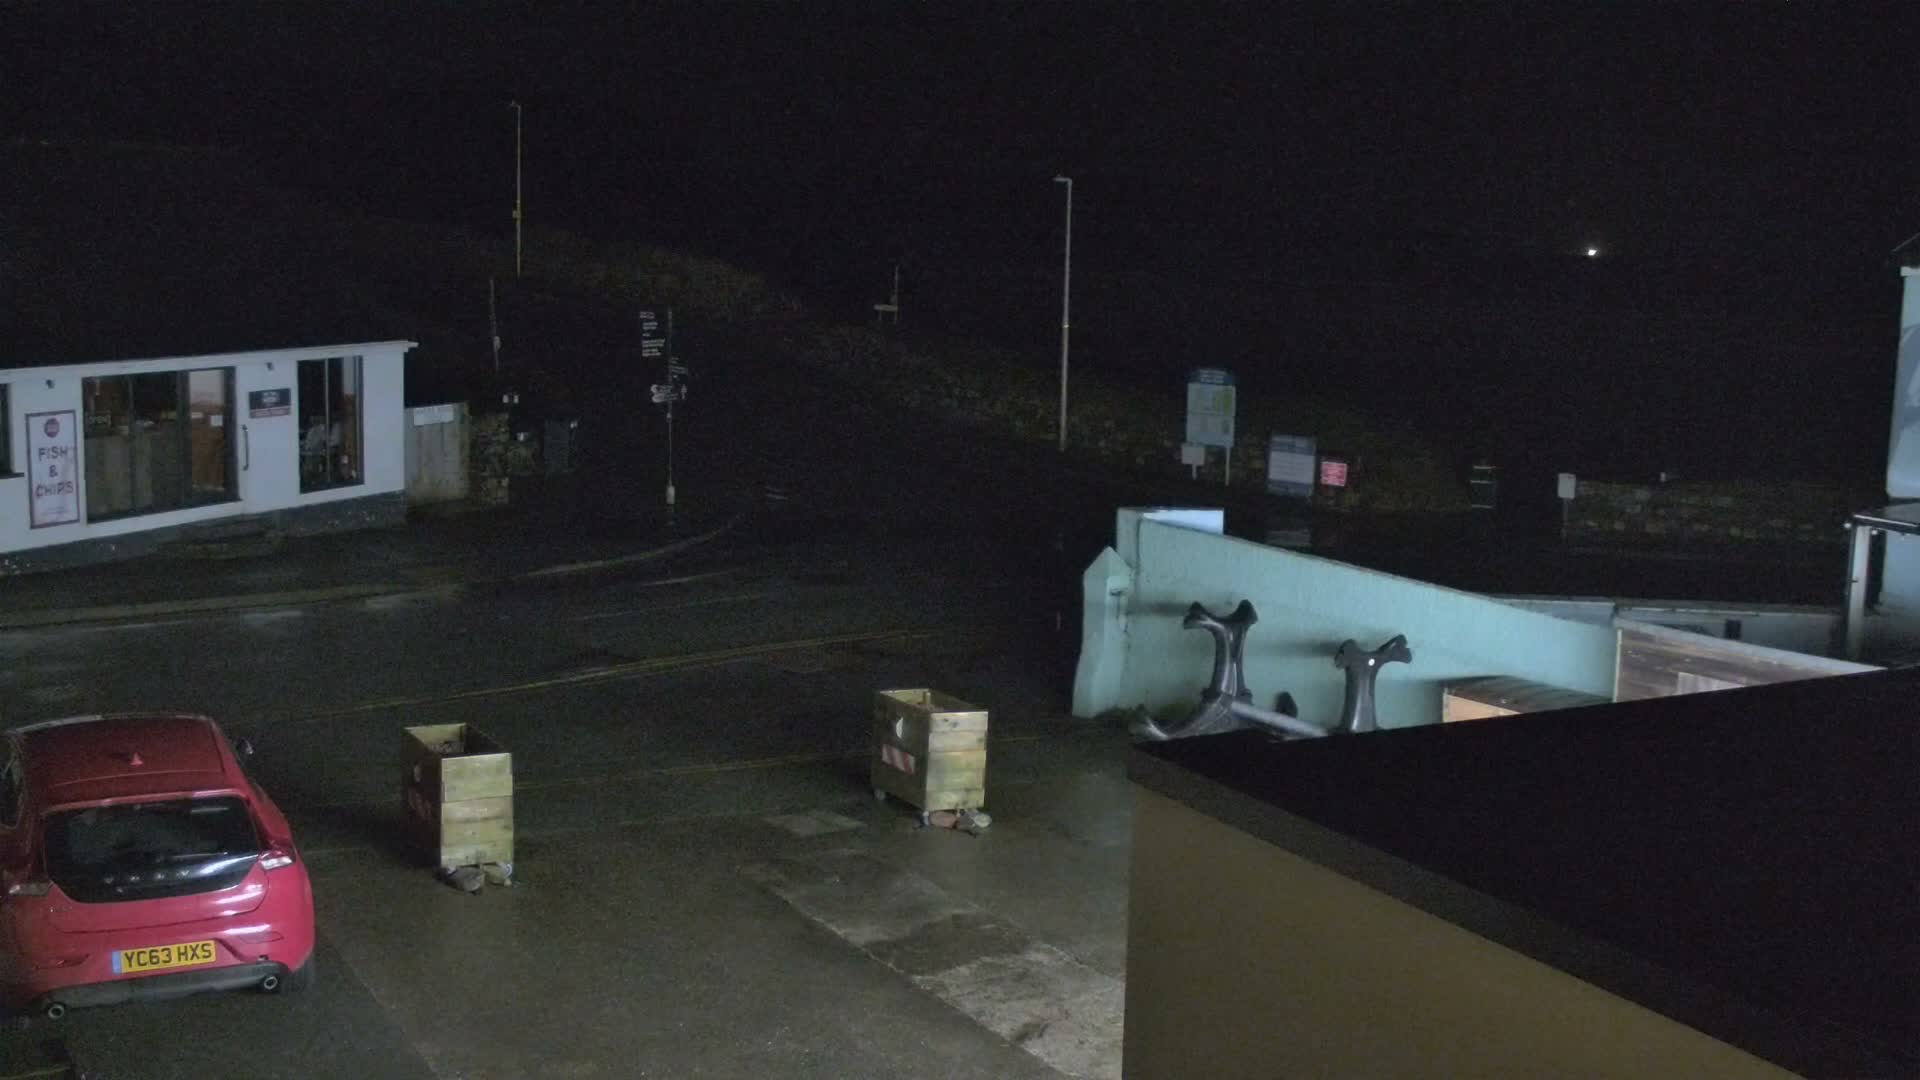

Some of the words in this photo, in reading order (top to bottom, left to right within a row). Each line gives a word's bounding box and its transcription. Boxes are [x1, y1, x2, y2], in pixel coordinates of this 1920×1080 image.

[38, 446, 67, 461] FISH
[49, 464, 58, 477] &
[35, 481, 74, 498] CHIPS
[124, 948, 172, 968] YC63
[177, 943, 212, 962] HXS
